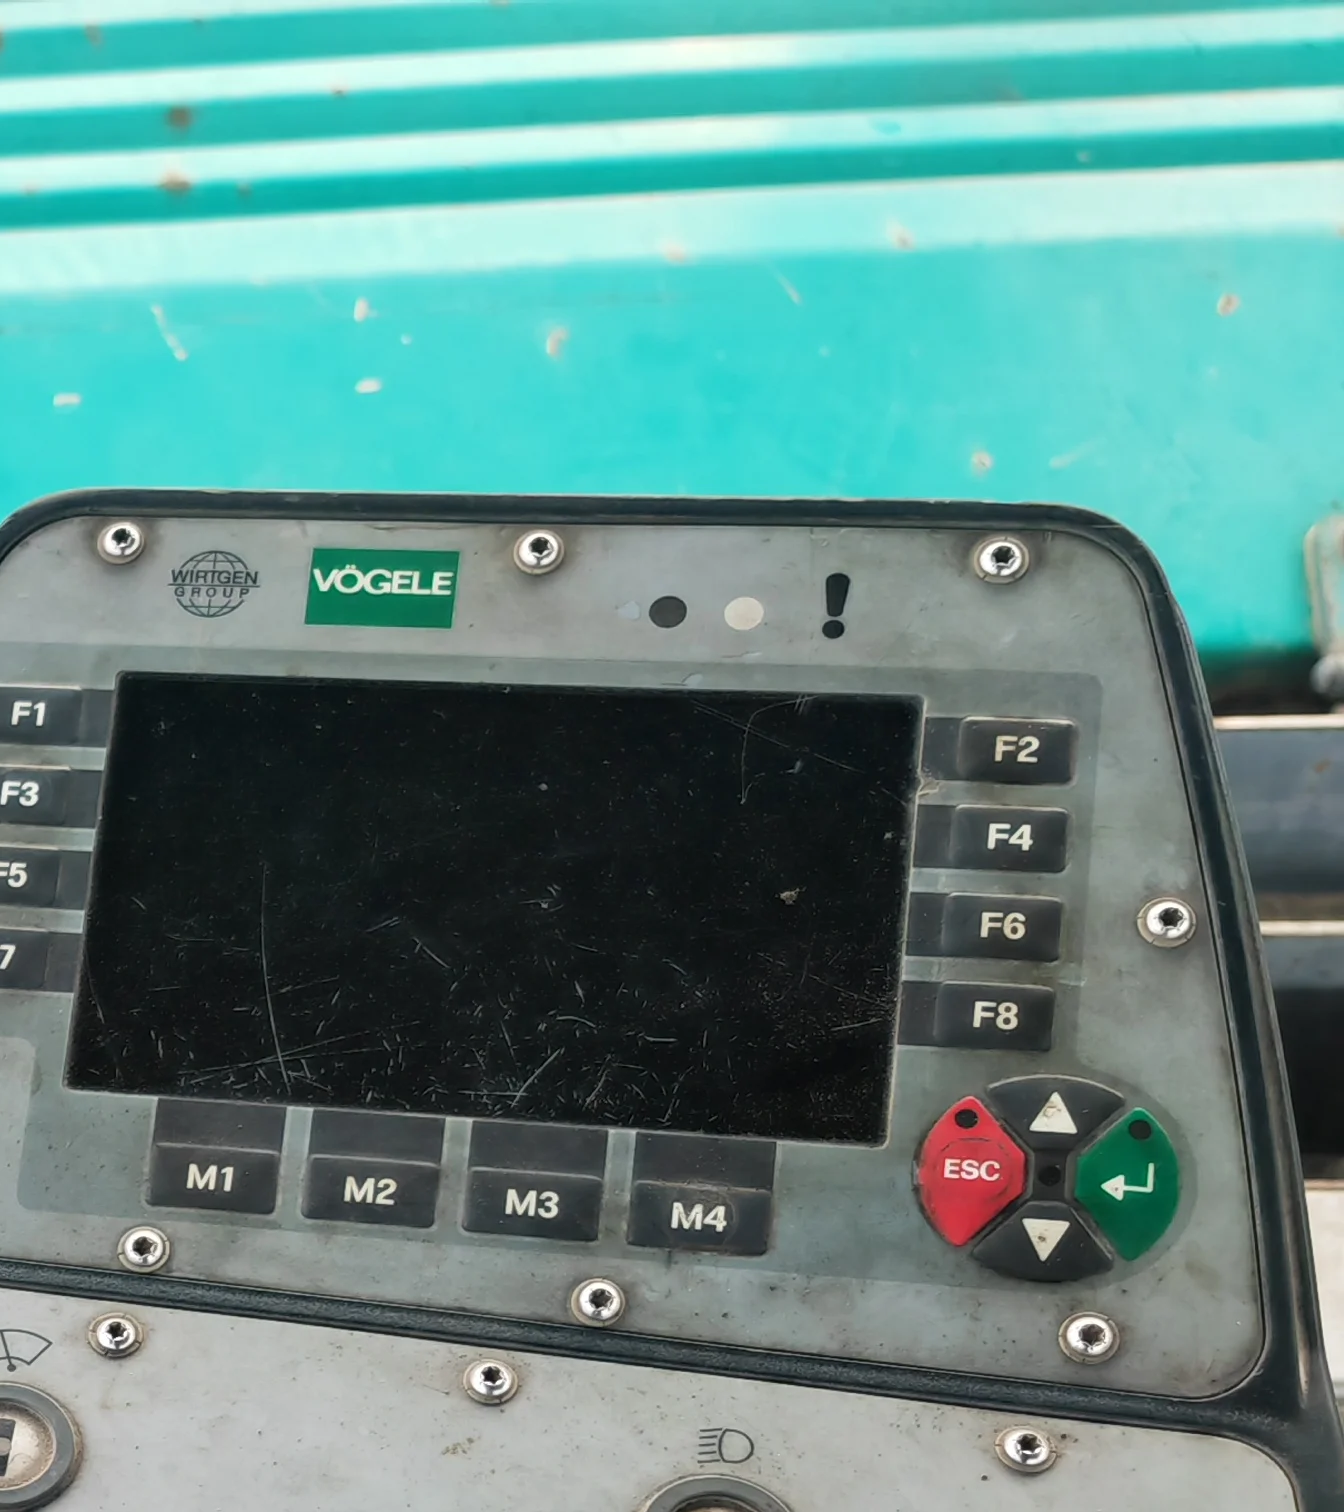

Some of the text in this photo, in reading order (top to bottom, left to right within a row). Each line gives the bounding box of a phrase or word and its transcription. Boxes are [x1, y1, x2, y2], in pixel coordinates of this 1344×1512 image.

[170, 569, 259, 586] WIRTGEN
[313, 564, 454, 596] VÖGELE
[174, 586, 250, 599] GROUP
[11, 700, 46, 727] F1
[994, 735, 1040, 763] F2
[0, 780, 40, 807] F3
[987, 823, 1034, 851] F4
[980, 911, 1026, 940] F6
[972, 1000, 1018, 1030] F8
[186, 1163, 234, 1192] M1
[943, 1158, 1001, 1181] ESC
[343, 1175, 398, 1205] M2
[505, 1188, 560, 1219] M3
[670, 1201, 727, 1232] M4
